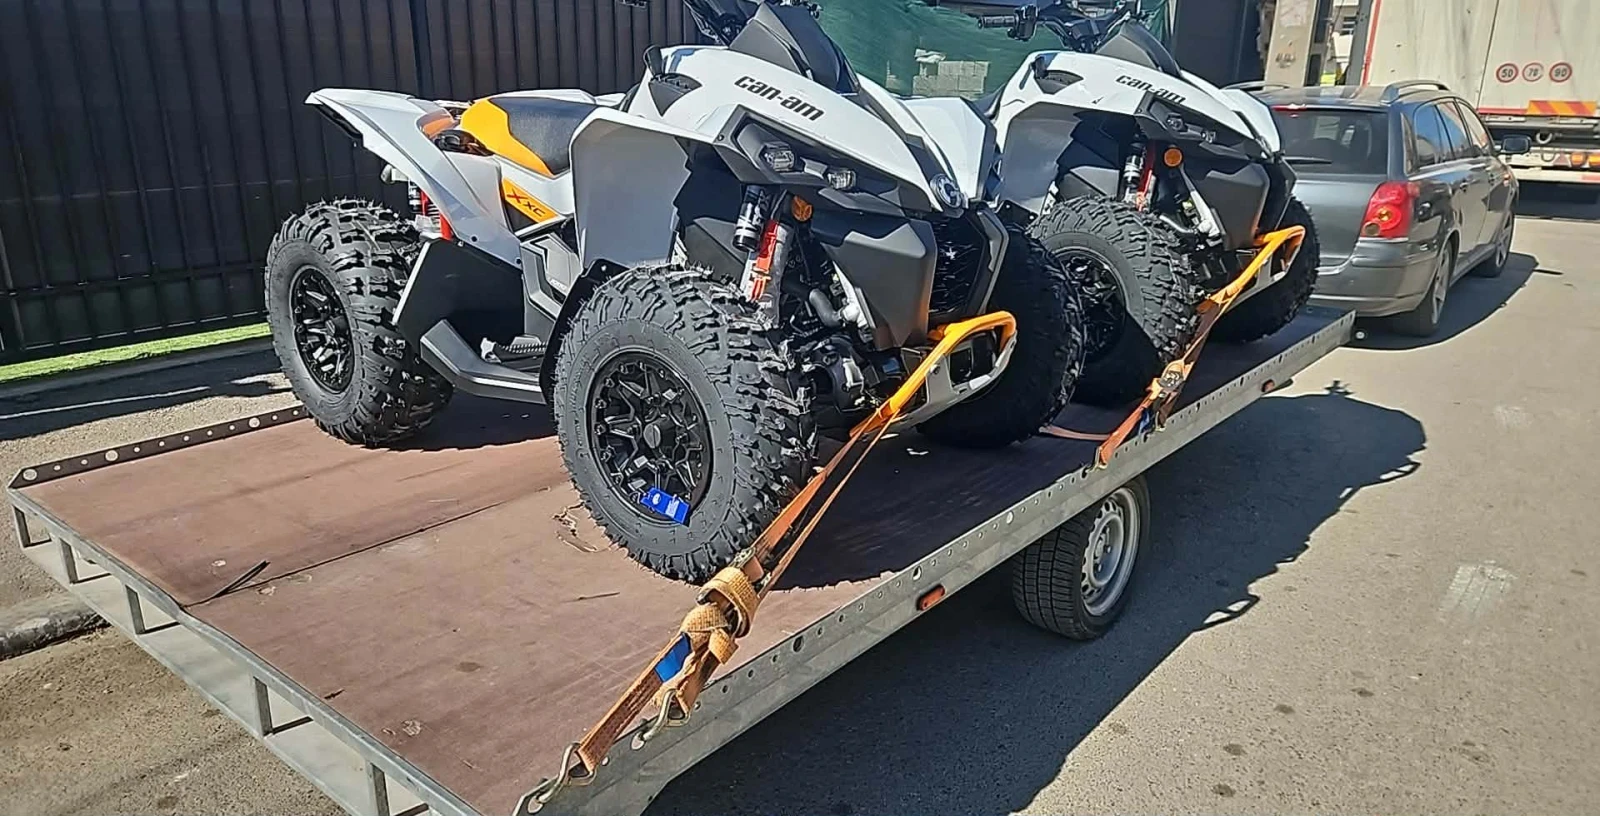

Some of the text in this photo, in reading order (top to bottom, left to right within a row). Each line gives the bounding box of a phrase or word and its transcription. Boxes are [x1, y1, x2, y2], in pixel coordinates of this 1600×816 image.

[1501, 67, 1514, 78] 50
[1554, 67, 1567, 78] 90
[734, 75, 825, 121] can-am
[1115, 75, 1187, 104] can-am
